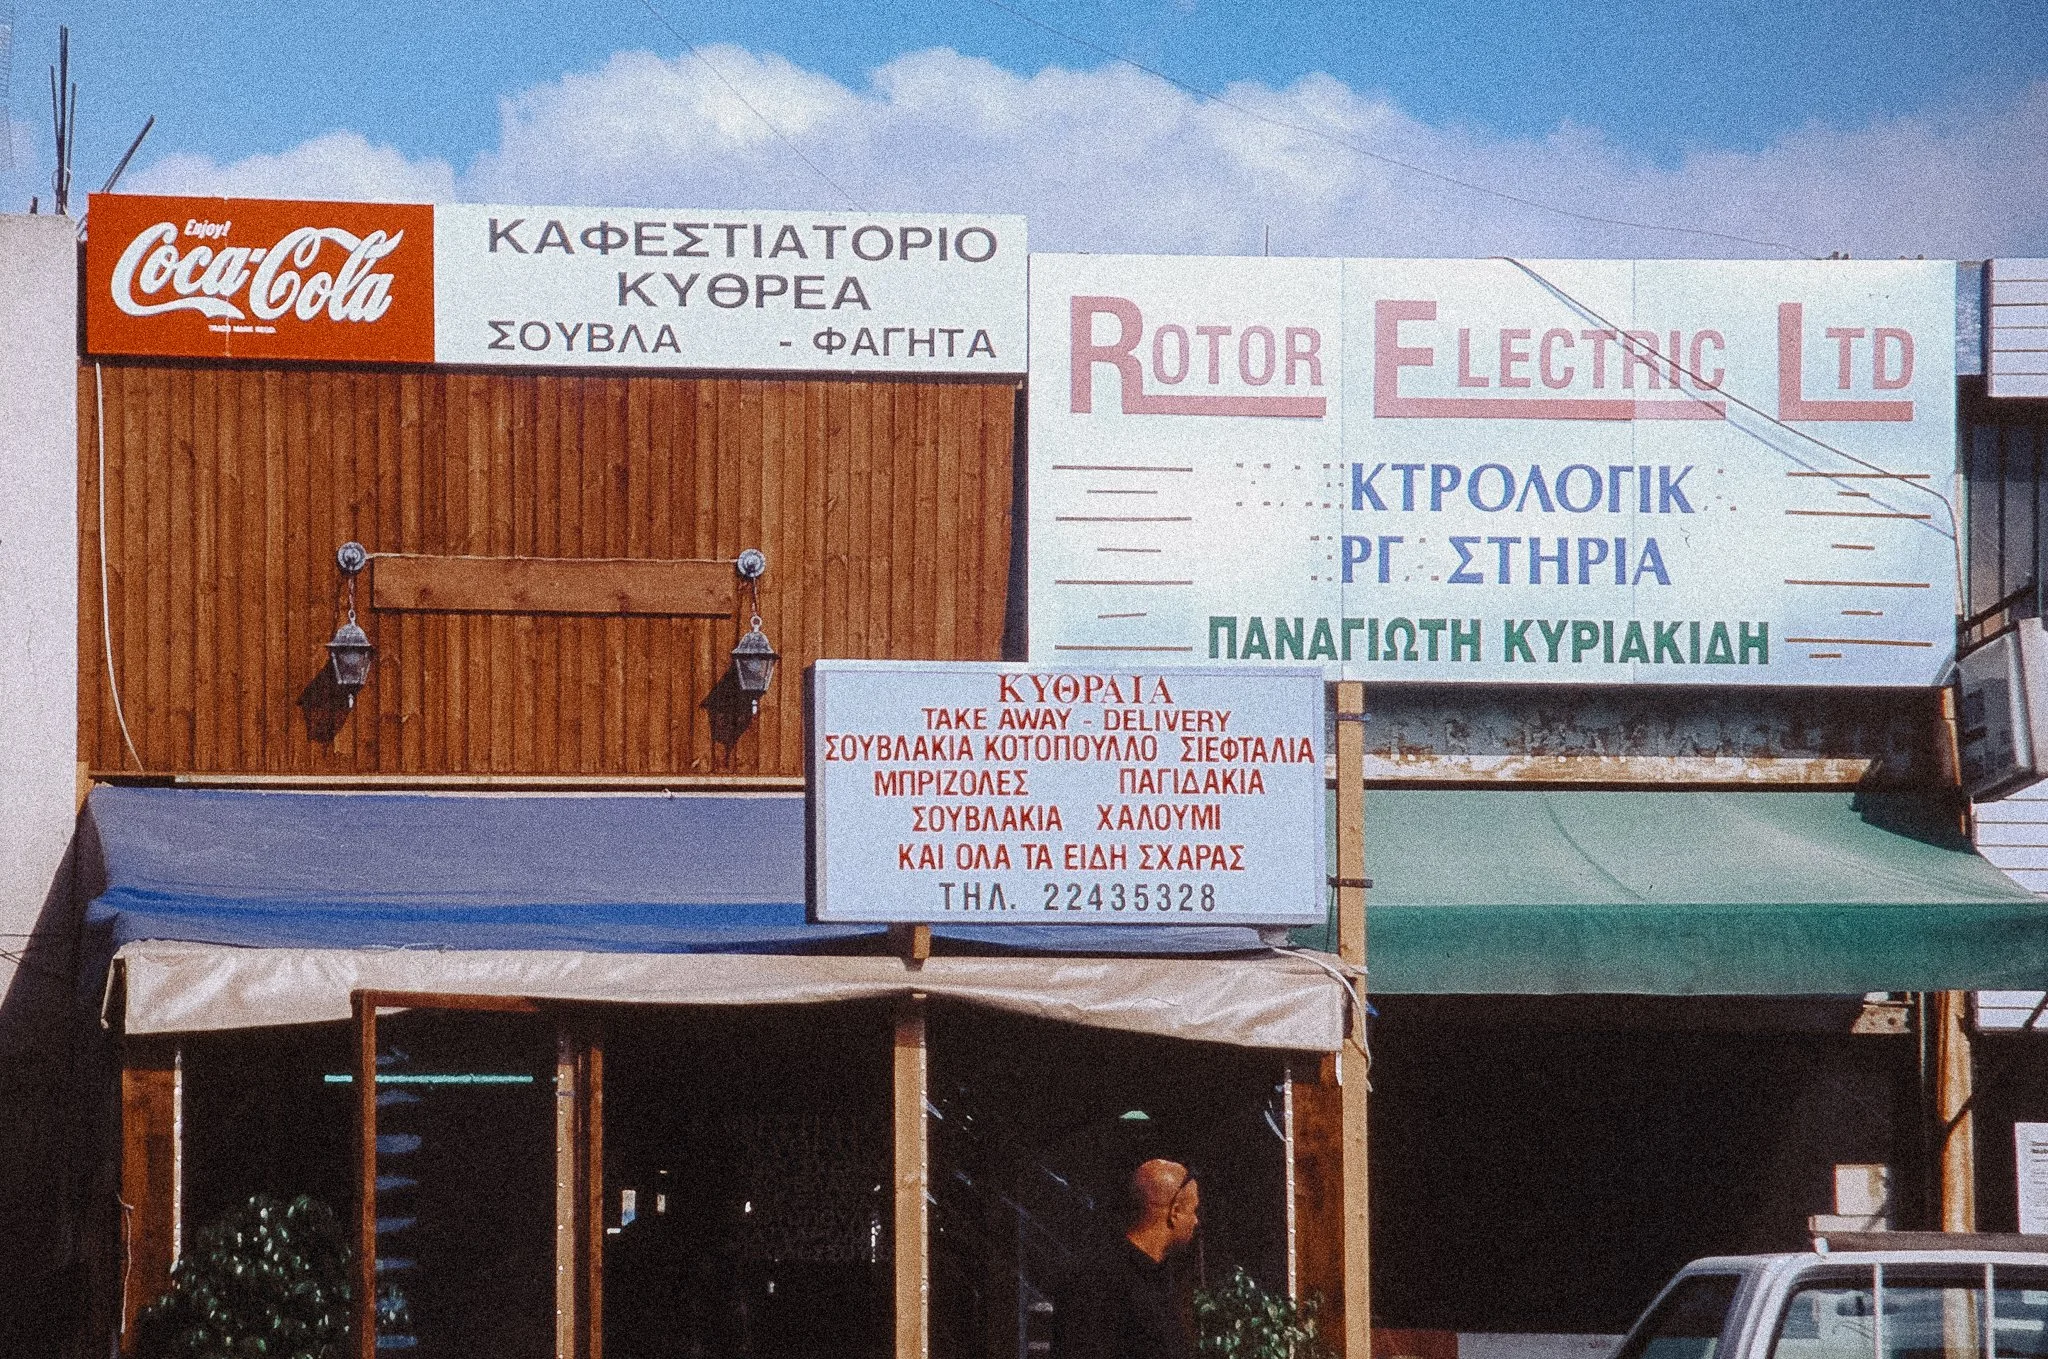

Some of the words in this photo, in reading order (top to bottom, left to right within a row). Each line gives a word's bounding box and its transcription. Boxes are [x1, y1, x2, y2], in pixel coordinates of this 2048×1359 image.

[184, 219, 231, 239] Enjoy!
[489, 219, 997, 262] ΚΑΦΕΣΤΙΑΤΟΡΙΟ
[111, 222, 403, 322] Coca-Cola
[619, 273, 870, 310] ΚΥΘΡΕΑ
[488, 321, 681, 353] ΣΟΥΒΛΑ
[813, 327, 996, 358] ΦΑΓΗΤΑ
[1070, 296, 1327, 418] ROTOR
[1374, 301, 1727, 420] ELECTRIC
[1208, 616, 1482, 662] ΠΑΝΑΓΙΩΤΗ
[1505, 620, 1769, 665] ΚΥΡΙΑΚΙΔΗ
[1000, 675, 1172, 703] ΚΥΘΡΑΙΑ
[923, 709, 985, 729] TAKE
[999, 709, 1070, 729] AWAY
[1104, 710, 1230, 732] DELIVERY
[825, 735, 973, 761] ΣΟΥΒΛΑΚΙΑ
[985, 735, 1157, 761] ΚΟΤΟΠΟΥΛΛΟ
[1181, 737, 1314, 763] ΣΙΕΦΤΑΛΙΑ
[875, 770, 1028, 796] ΜΠΡΙΖΟΛΕΣ
[1120, 769, 1264, 794] ΠΑΓΙΔΑΚΙΑ
[913, 806, 1062, 831] ΣΟΥΒΛΑΚΙΑ
[1098, 805, 1220, 830] ΧΑΛΟΥΜΙ
[899, 845, 943, 869] ΚΑΙ
[957, 844, 1010, 870] ΟΛΑ
[1022, 844, 1052, 869] ΤΑ
[1065, 844, 1126, 870] ΕΙΔΗ
[1140, 845, 1244, 870] ΣΧΑΡΑΣ
[939, 883, 1015, 910] ΤΗΛ.
[1044, 883, 1215, 912] 22435328
